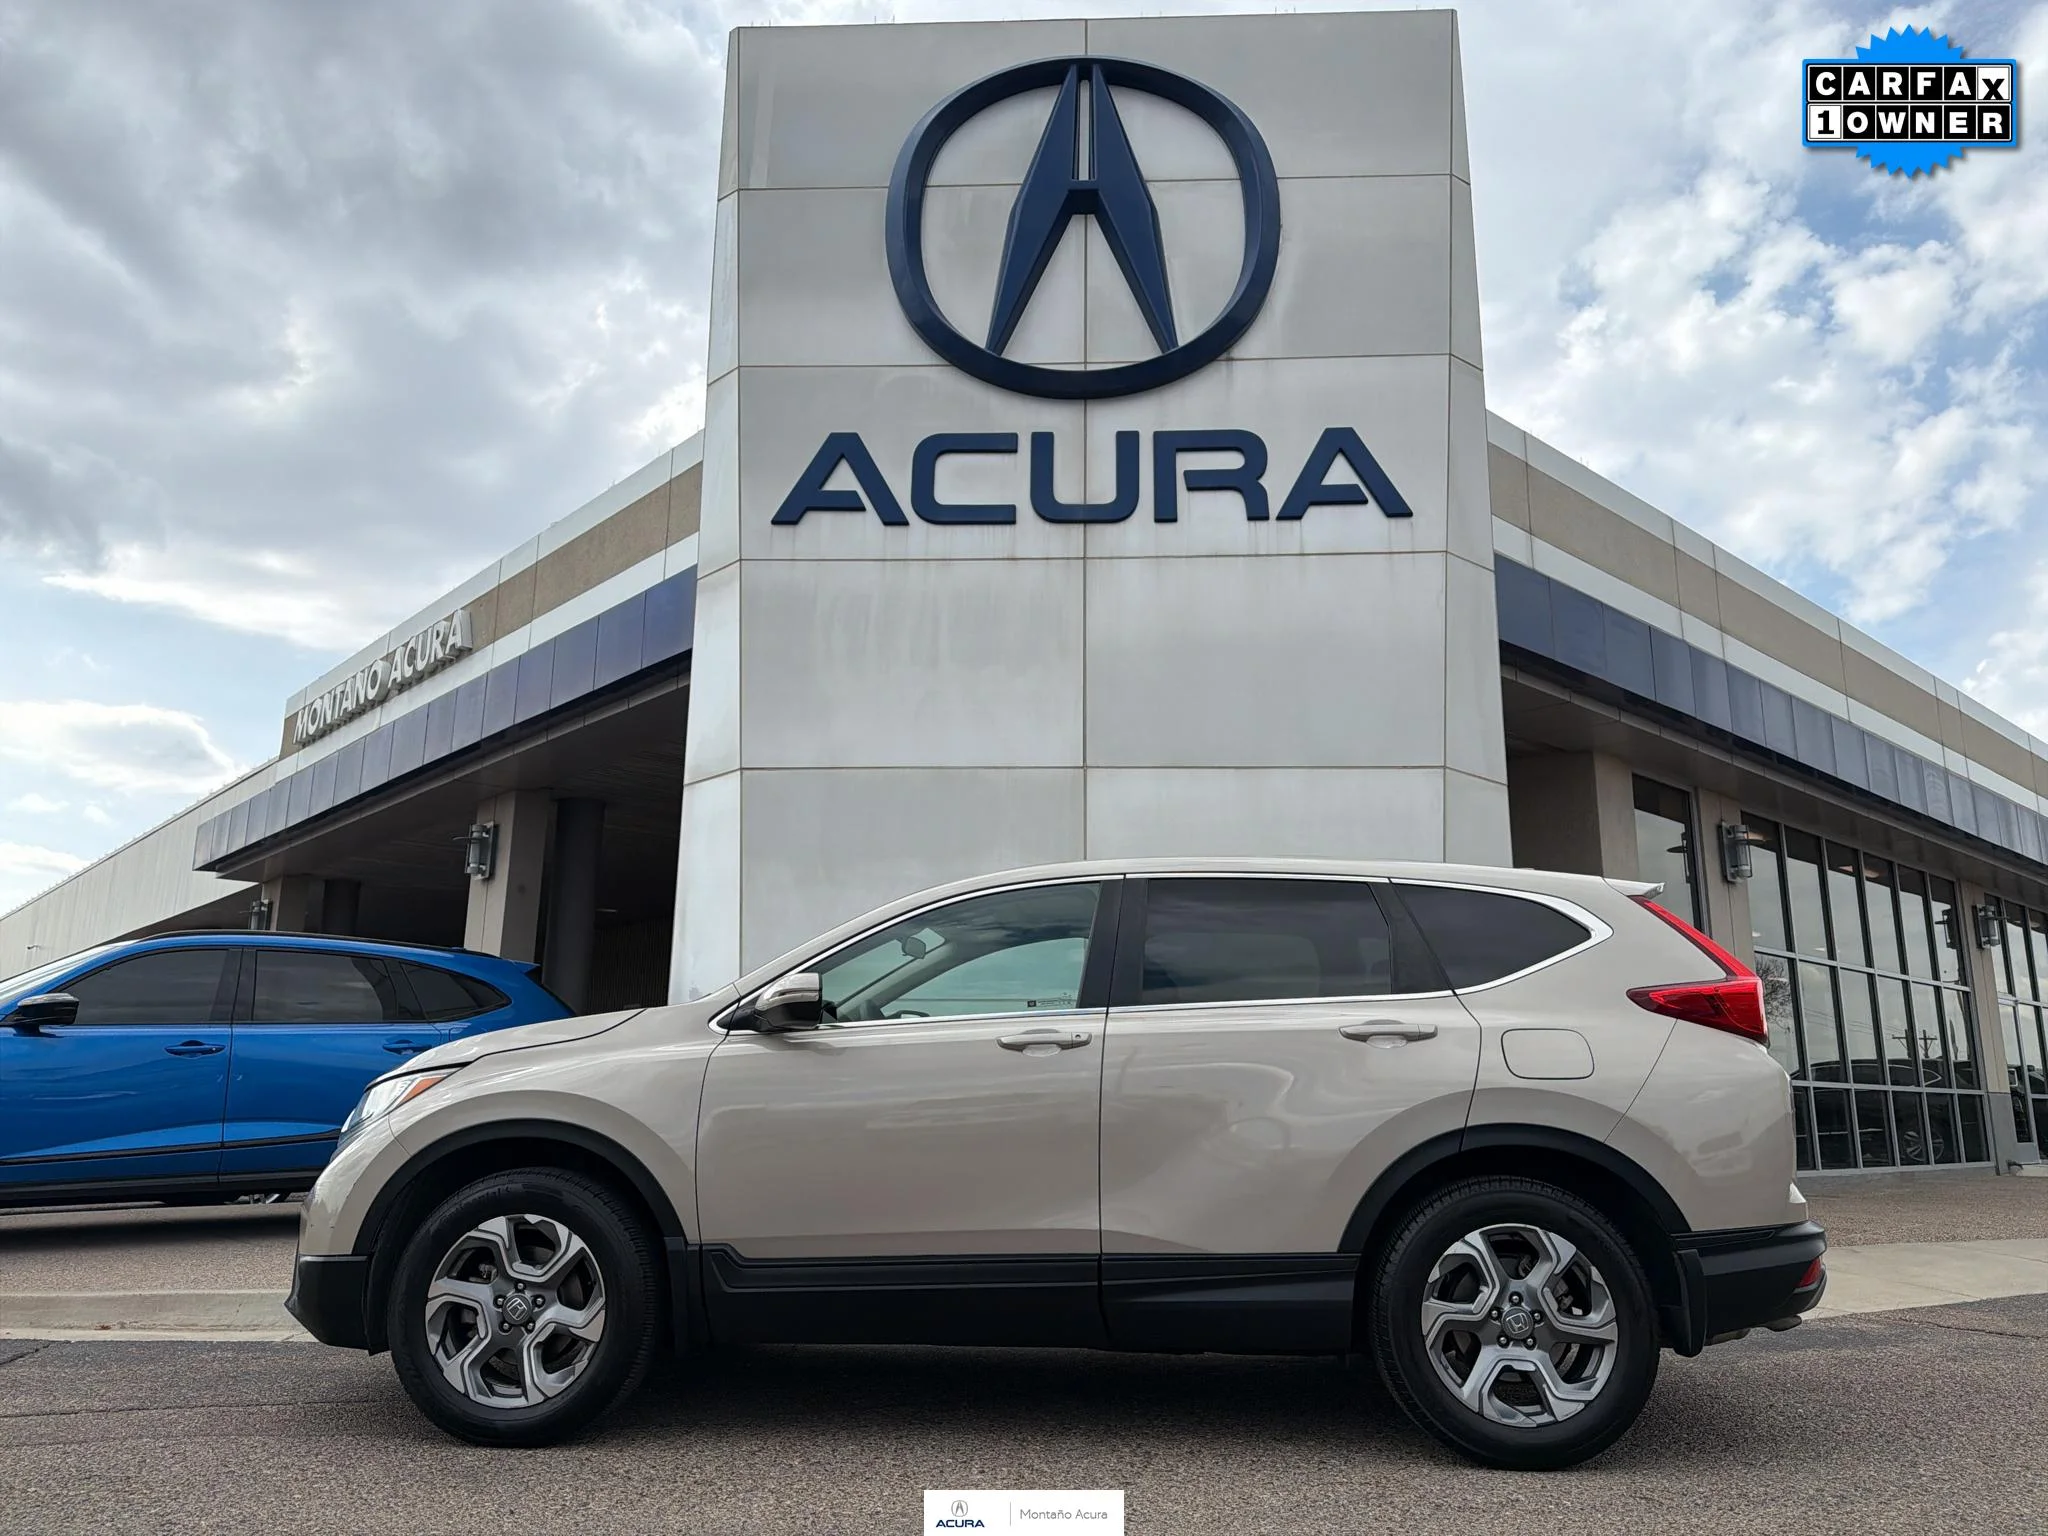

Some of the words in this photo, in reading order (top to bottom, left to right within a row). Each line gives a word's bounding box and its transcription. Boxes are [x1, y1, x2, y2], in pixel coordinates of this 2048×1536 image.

[771, 427, 1413, 526] ACURA
[293, 659, 386, 744] MONTANO
[388, 609, 470, 688] ACURA
